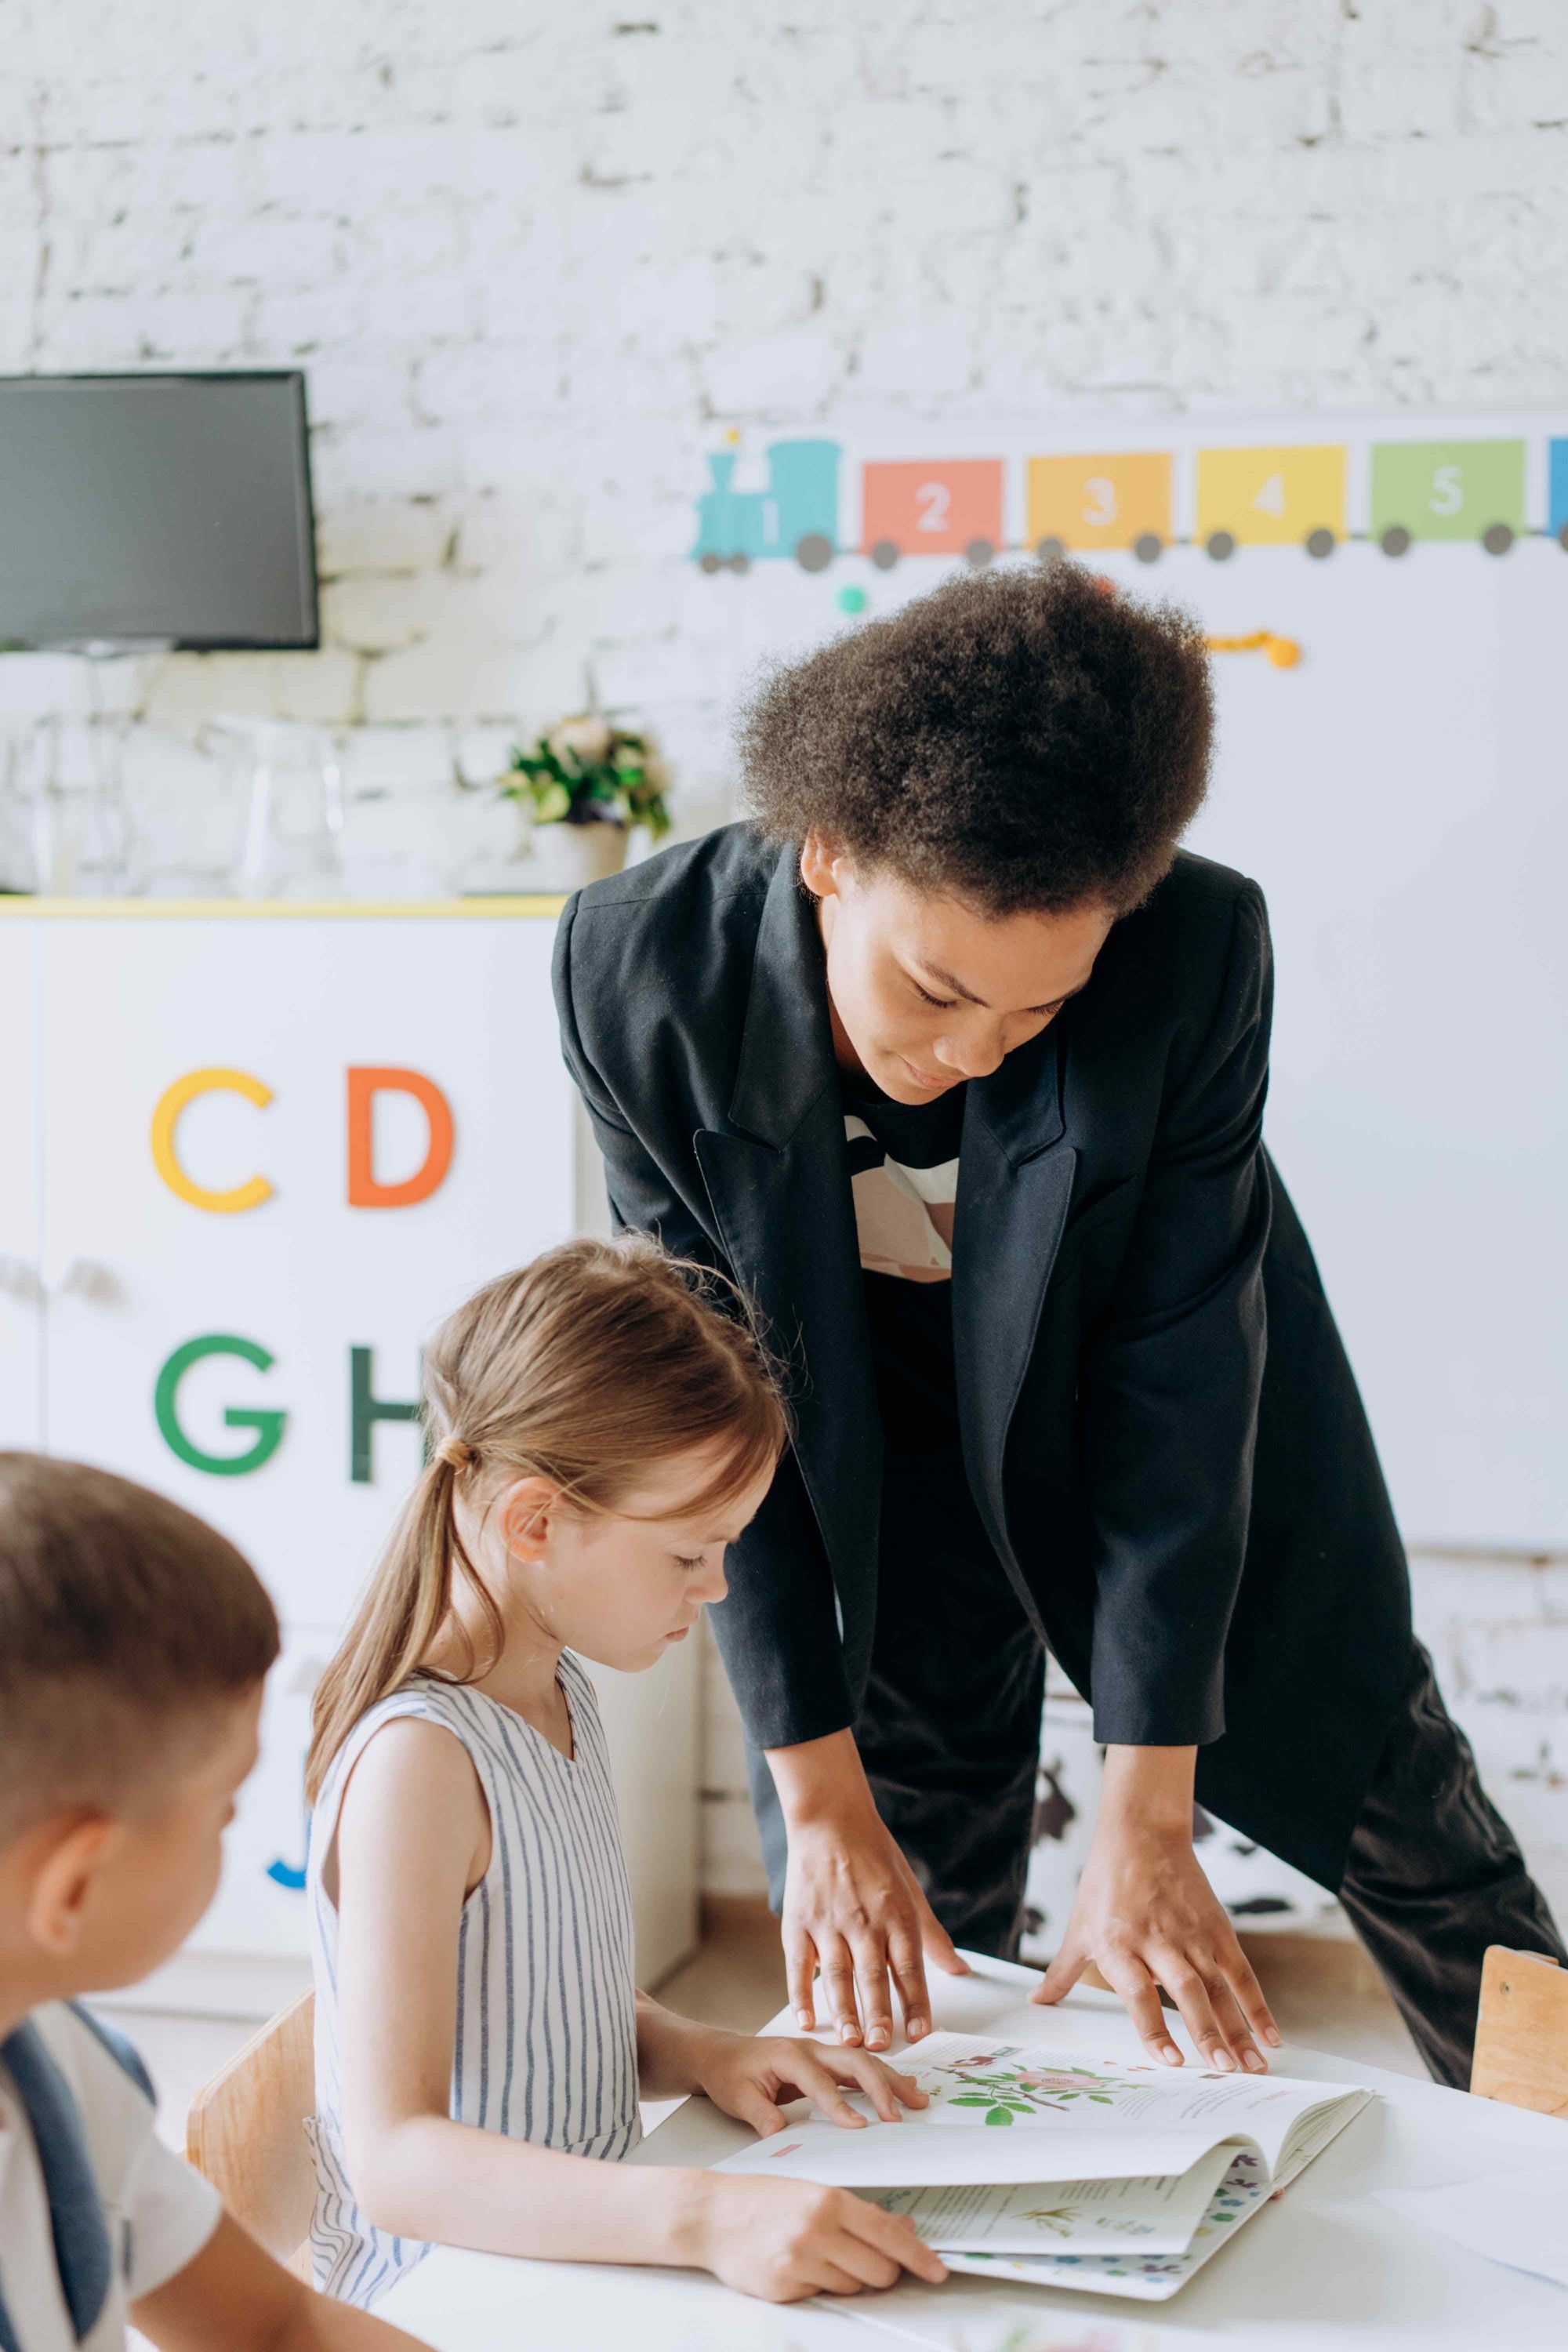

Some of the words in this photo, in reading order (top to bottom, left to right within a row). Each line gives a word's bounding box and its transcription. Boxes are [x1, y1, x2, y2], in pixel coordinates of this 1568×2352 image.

[916, 481, 951, 532] 2
[1081, 477, 1118, 526] 3
[1252, 472, 1285, 518] 4
[1427, 465, 1465, 516] 5
[151, 1067, 276, 1214] C
[347, 1067, 455, 1208] D
[155, 1334, 288, 1476] G
[350, 1345, 430, 1483] H
